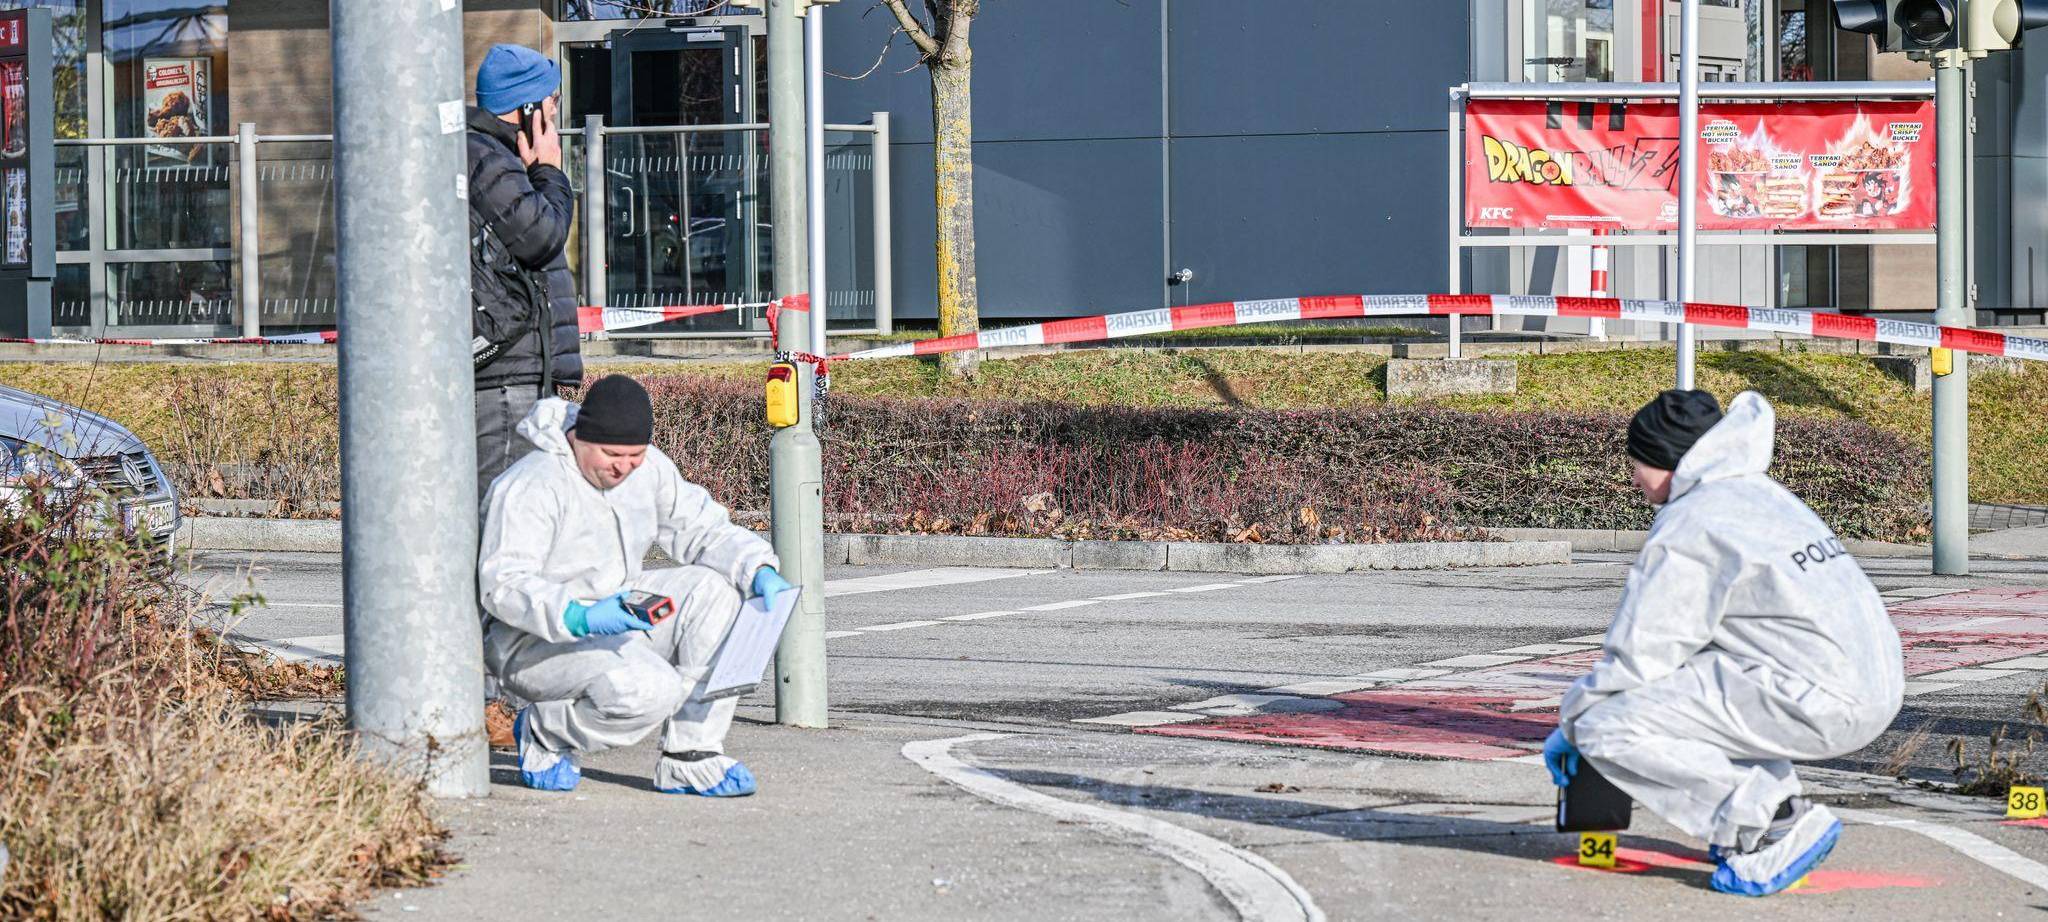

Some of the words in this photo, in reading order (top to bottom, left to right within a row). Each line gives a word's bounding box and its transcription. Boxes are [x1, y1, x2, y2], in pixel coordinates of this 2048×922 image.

[1482, 135, 1573, 186] DRAGON
[1573, 144, 1626, 187] BALL
[1480, 207, 1514, 219] KFC
[2011, 792, 2039, 811] 38
[1581, 838, 1613, 859] 34
